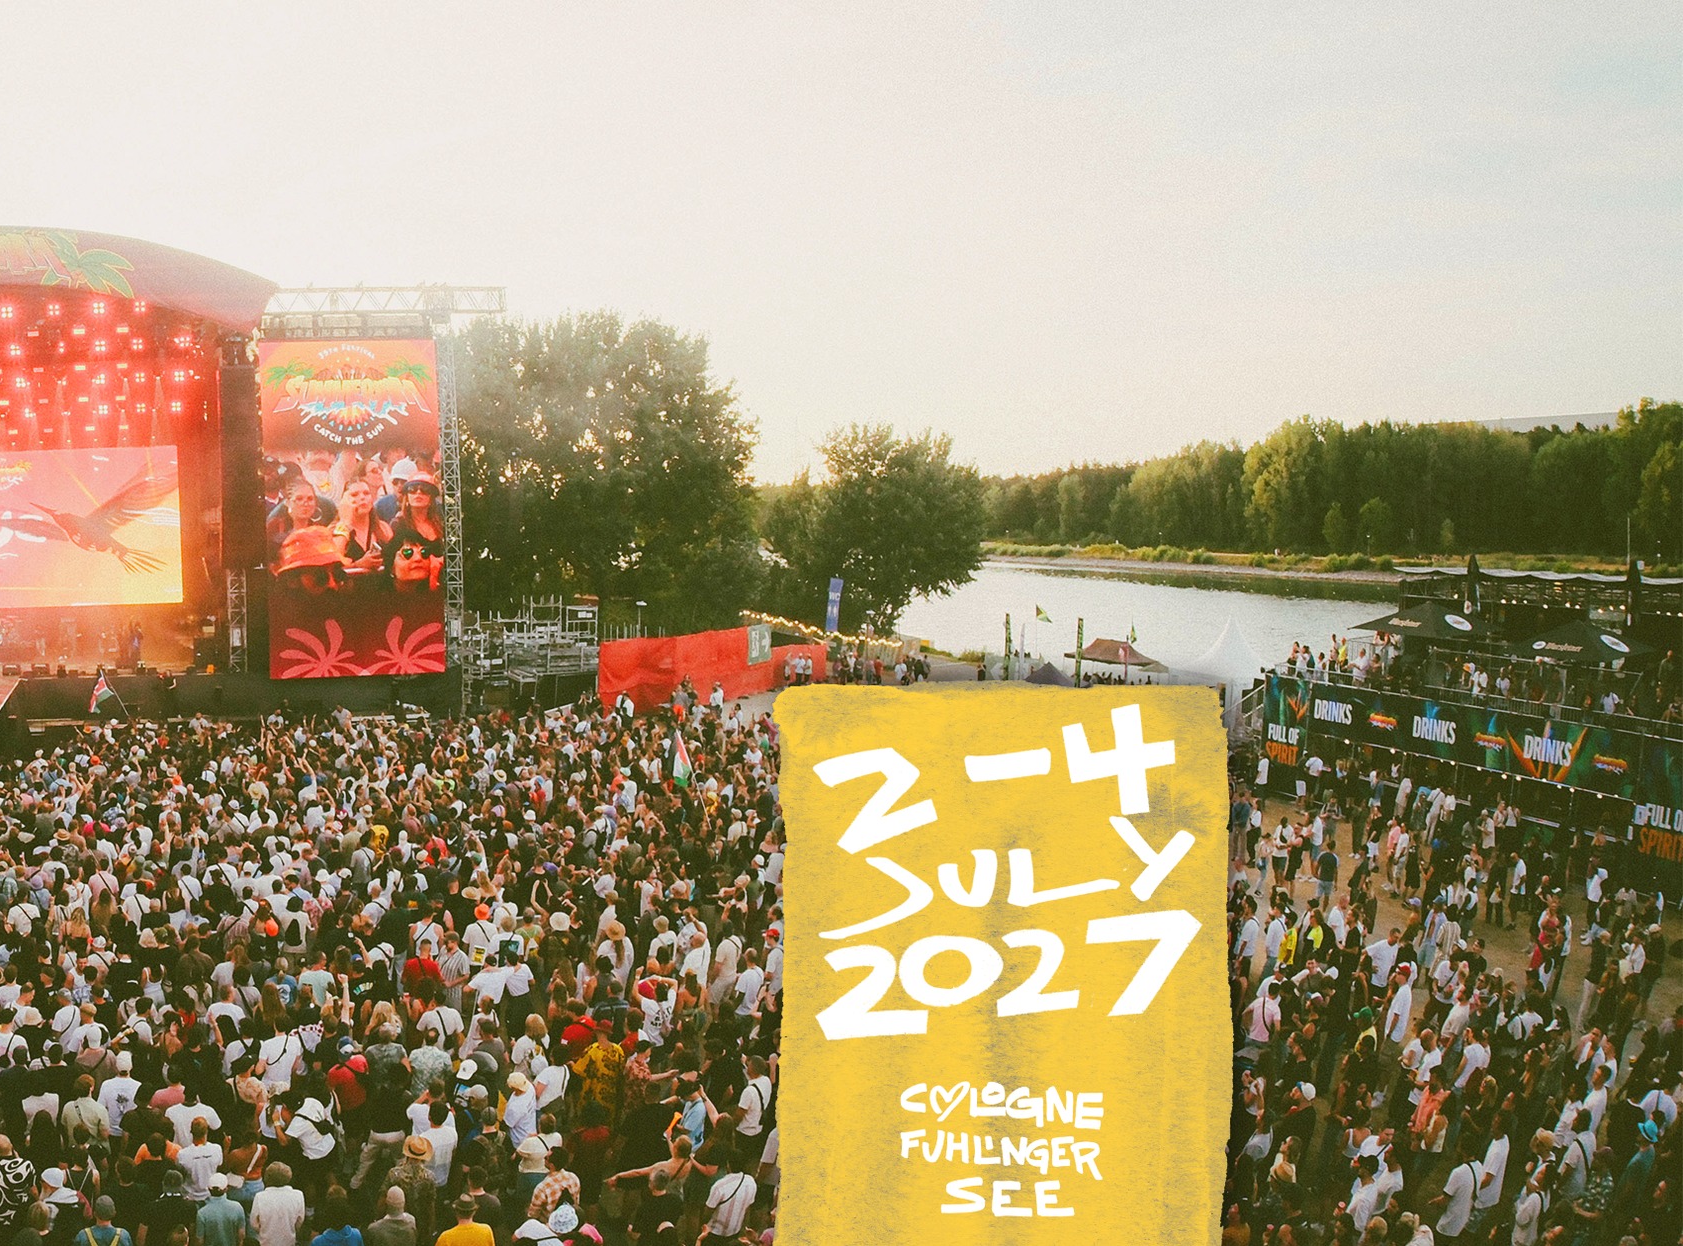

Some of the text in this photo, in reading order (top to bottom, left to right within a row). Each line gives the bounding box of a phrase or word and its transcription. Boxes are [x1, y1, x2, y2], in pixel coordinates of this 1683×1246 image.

[313, 422, 385, 446] CATCH THE SUN
[1314, 698, 1353, 726] DRINKS
[1267, 722, 1300, 746] FULL OF
[1412, 715, 1456, 745] DRINKS
[1266, 740, 1299, 767] SPIRIT
[1523, 734, 1573, 767] DRINKS
[1644, 802, 1672, 830] FULL
